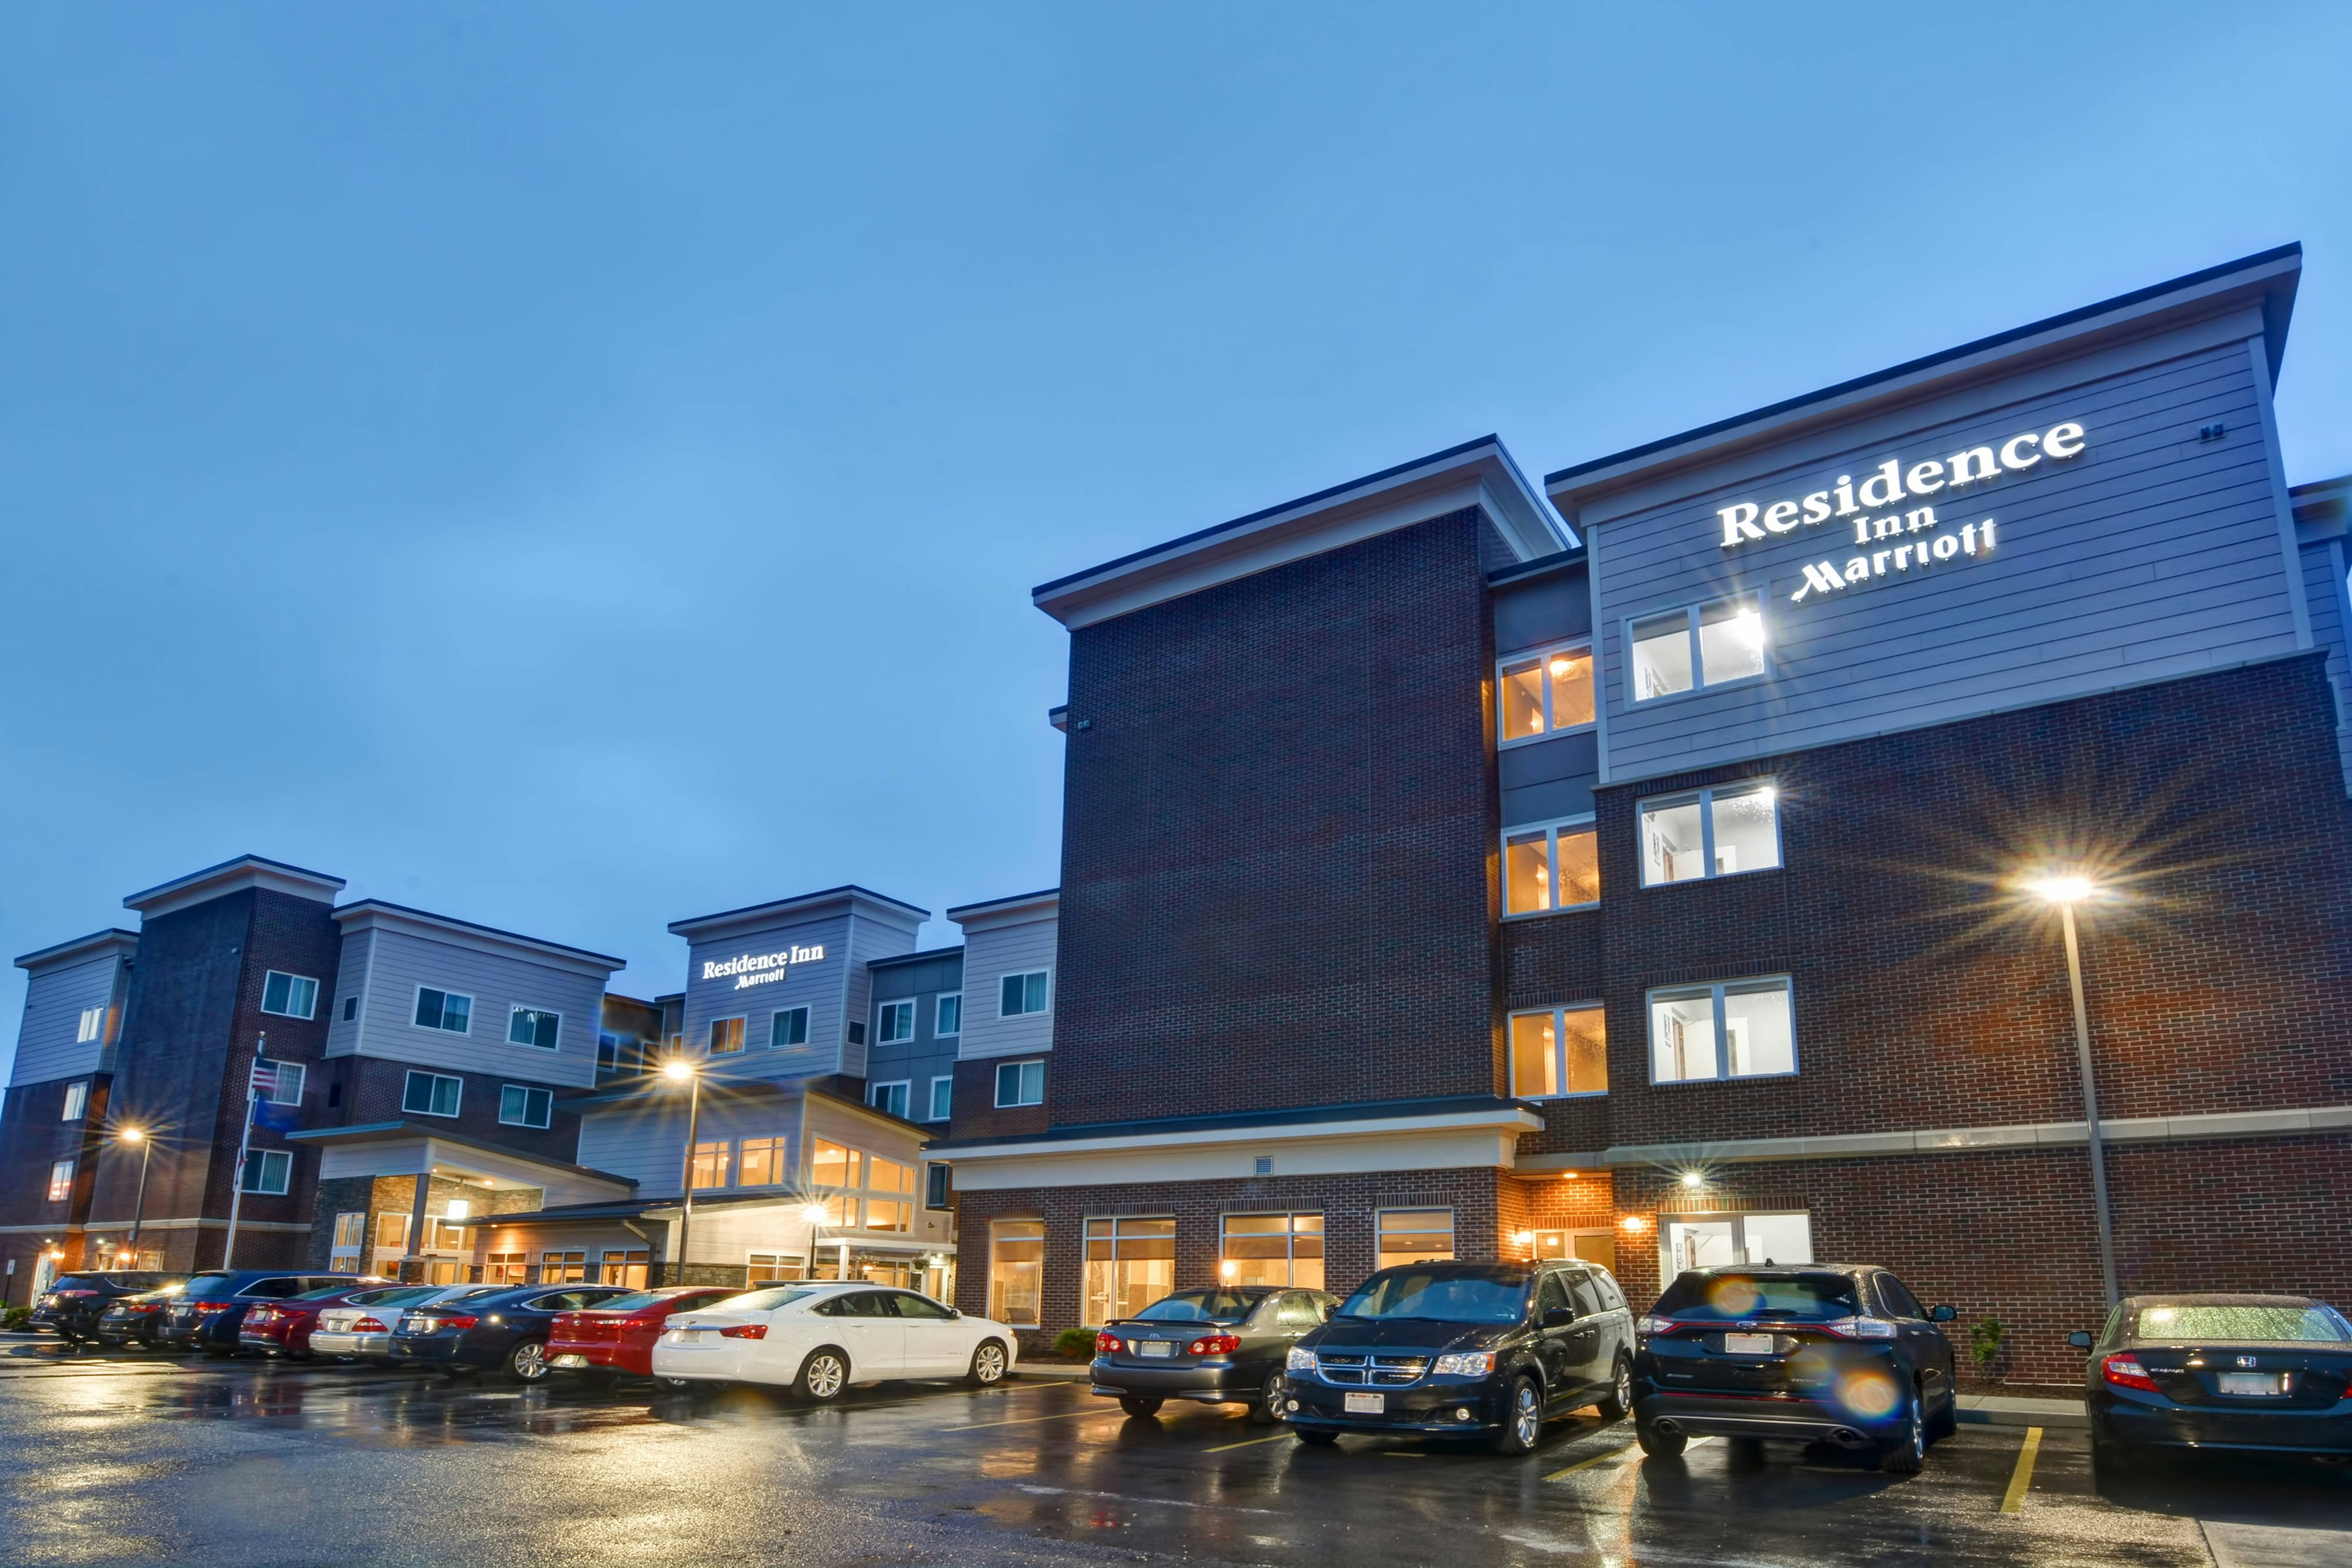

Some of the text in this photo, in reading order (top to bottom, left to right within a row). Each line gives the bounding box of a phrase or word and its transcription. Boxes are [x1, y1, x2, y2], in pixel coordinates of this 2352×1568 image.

[1716, 422, 2086, 547] Residence
[1852, 506, 1939, 544] Inn
[1790, 517, 1997, 601] Marriott
[702, 945, 824, 979] Residence Inn
[734, 968, 785, 990] Marriott
